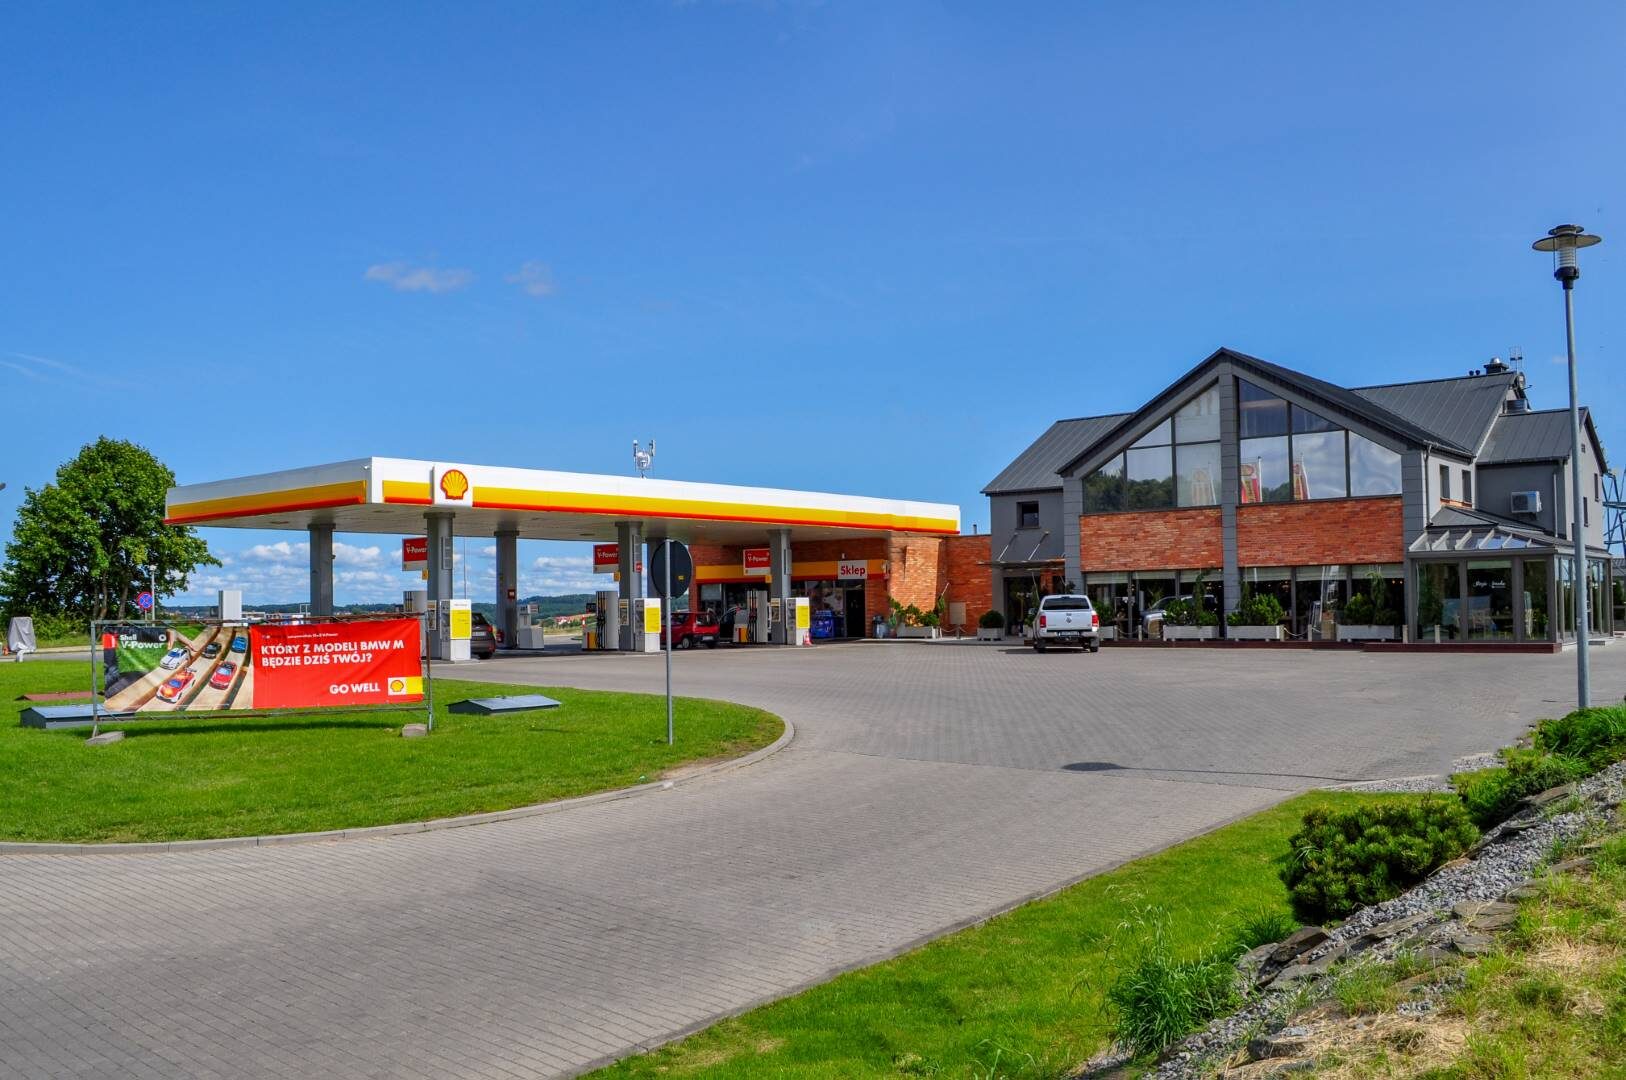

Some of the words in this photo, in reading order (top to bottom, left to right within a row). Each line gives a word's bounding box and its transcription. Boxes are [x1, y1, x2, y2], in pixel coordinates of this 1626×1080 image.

[841, 565, 866, 576] Sklep
[121, 641, 164, 649] V-Power
[261, 643, 300, 655] KTÓRY
[303, 644, 310, 653] Z
[314, 642, 358, 652] MODELI
[360, 640, 391, 650] BMW
[393, 639, 405, 649] M
[262, 656, 301, 669] BĘDZIE
[304, 653, 330, 665] DZIŚ
[333, 651, 373, 664] TWÓJ?
[329, 684, 349, 694] GO
[351, 682, 380, 693] WELL
